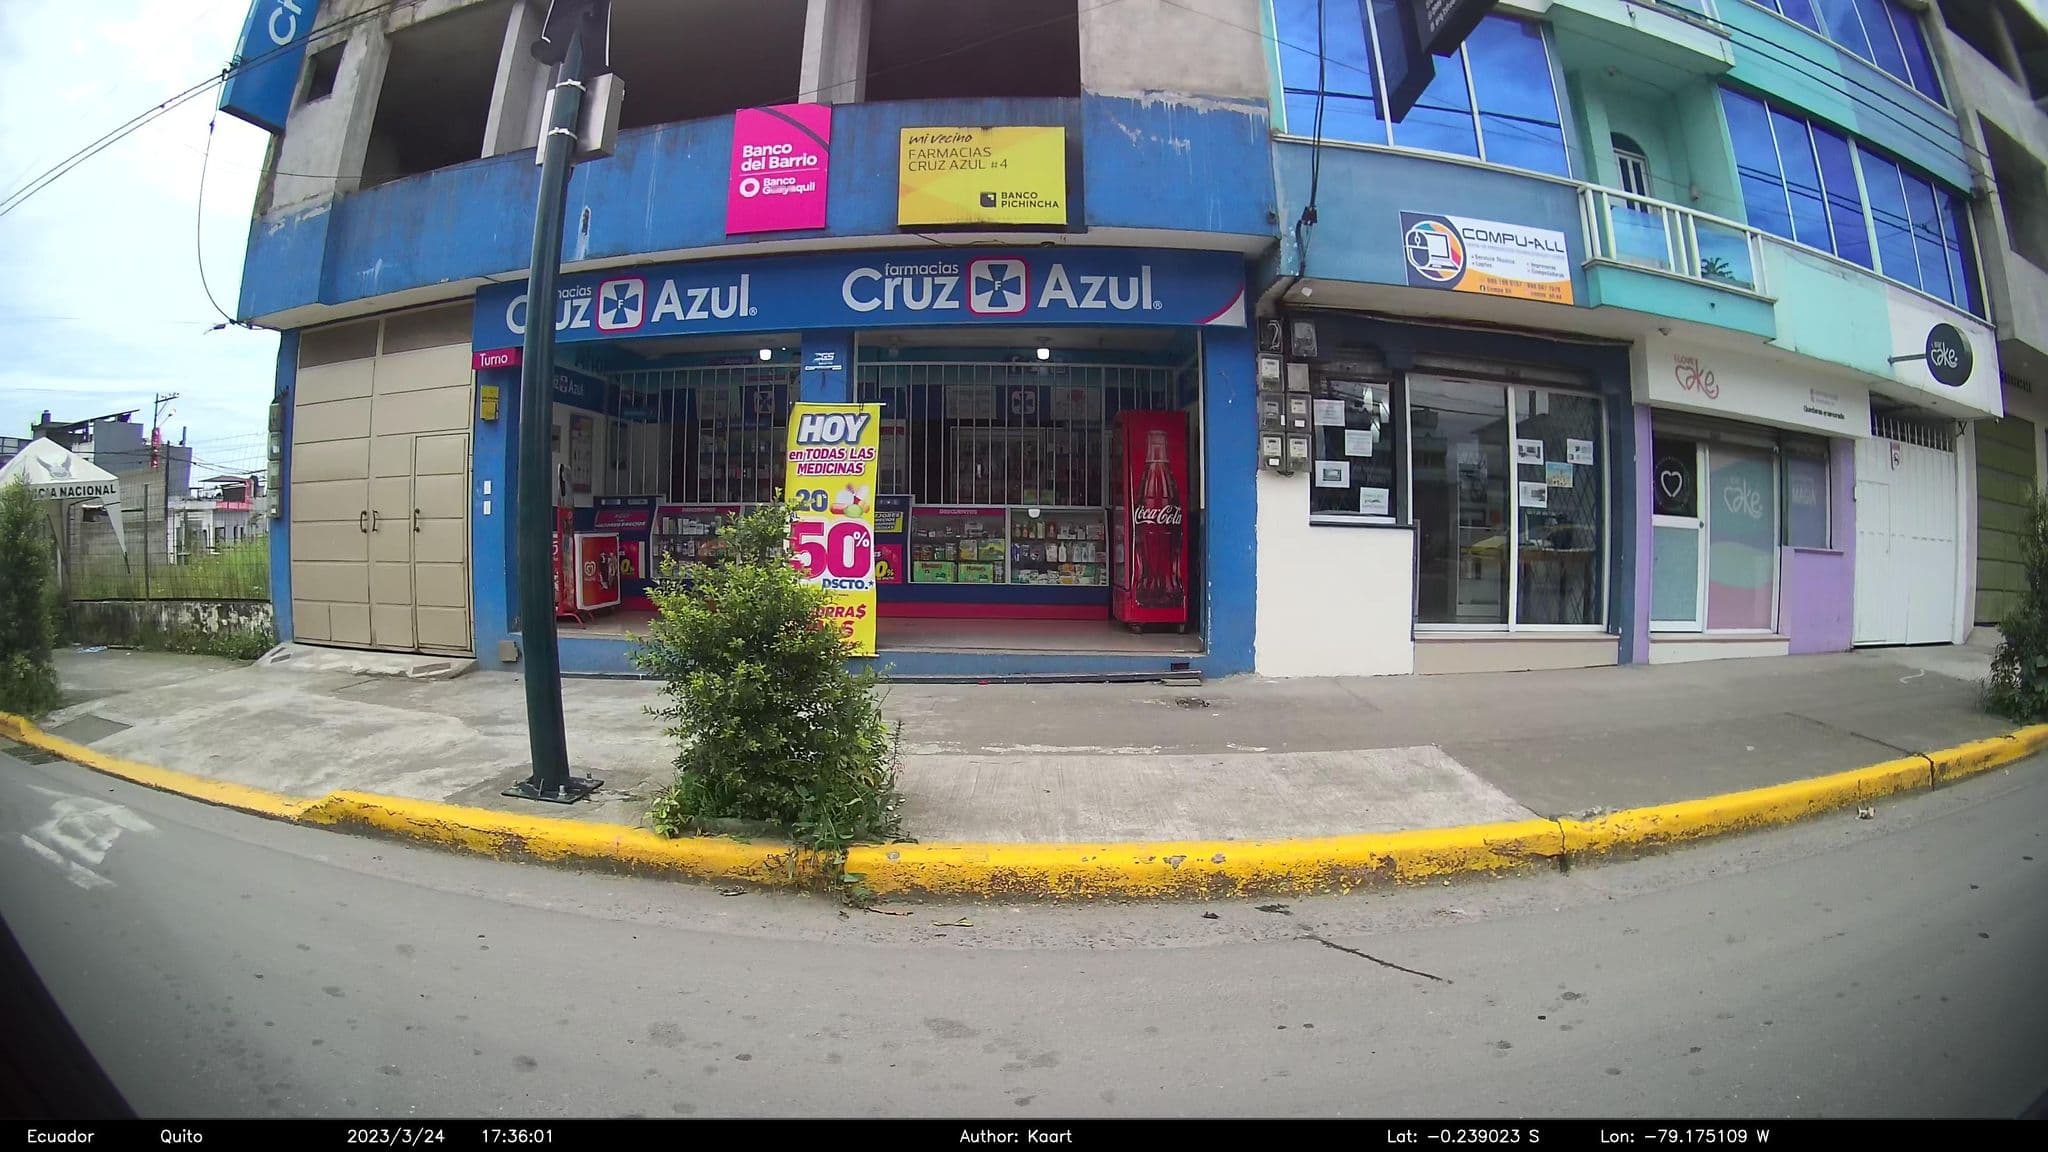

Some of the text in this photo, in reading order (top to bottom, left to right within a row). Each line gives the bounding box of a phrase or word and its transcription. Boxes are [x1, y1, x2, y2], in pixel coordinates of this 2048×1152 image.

[909, 132, 973, 145] mi vecino
[743, 142, 793, 158] Banco
[908, 147, 992, 160] FARMACIAS
[741, 153, 818, 172] del Barrio
[908, 160, 946, 172] CRUZ
[949, 158, 985, 170] AZUL
[763, 176, 797, 188] Banco
[1001, 192, 1038, 200] BANCO
[1001, 201, 1059, 209] PICHINCHA
[1462, 228, 1565, 253] COMPU-ALL
[885, 262, 958, 275] farmacias
[841, 268, 959, 312] Cruz
[479, 353, 508, 367] Turno
[798, 412, 870, 444] HOY
[789, 447, 875, 461] en TODAS LAS
[797, 462, 864, 475] MEDICINAS
[60, 484, 116, 497] NACIONAL
[796, 489, 828, 512] 20
[1134, 505, 1182, 525] Coca-Cola
